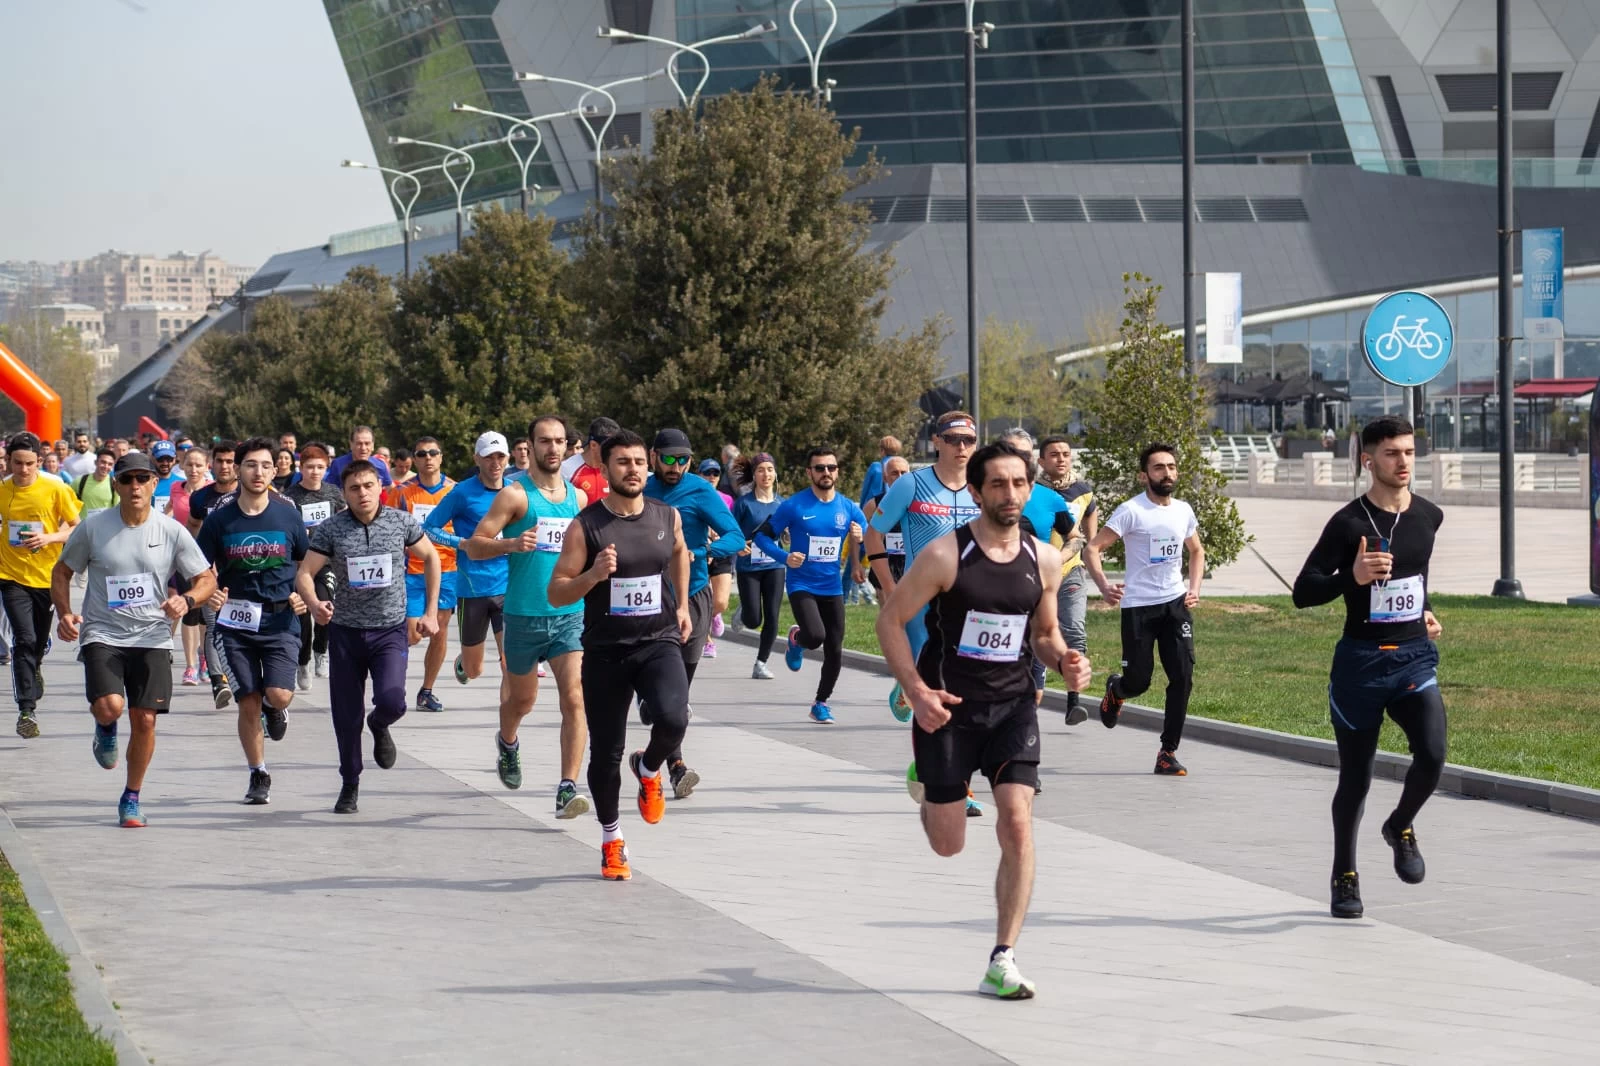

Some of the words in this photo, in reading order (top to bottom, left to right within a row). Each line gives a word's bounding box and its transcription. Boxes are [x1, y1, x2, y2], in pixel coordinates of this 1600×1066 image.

[310, 511, 326, 520] 185
[230, 541, 254, 555] Hard
[256, 540, 280, 554] Rock
[817, 546, 836, 556] 162
[1160, 544, 1178, 556] 167
[359, 567, 384, 580] 174
[118, 586, 144, 600] 099
[624, 591, 652, 606] 184
[1385, 594, 1414, 611] 198
[230, 609, 252, 623] 098
[978, 631, 1011, 649] 084
